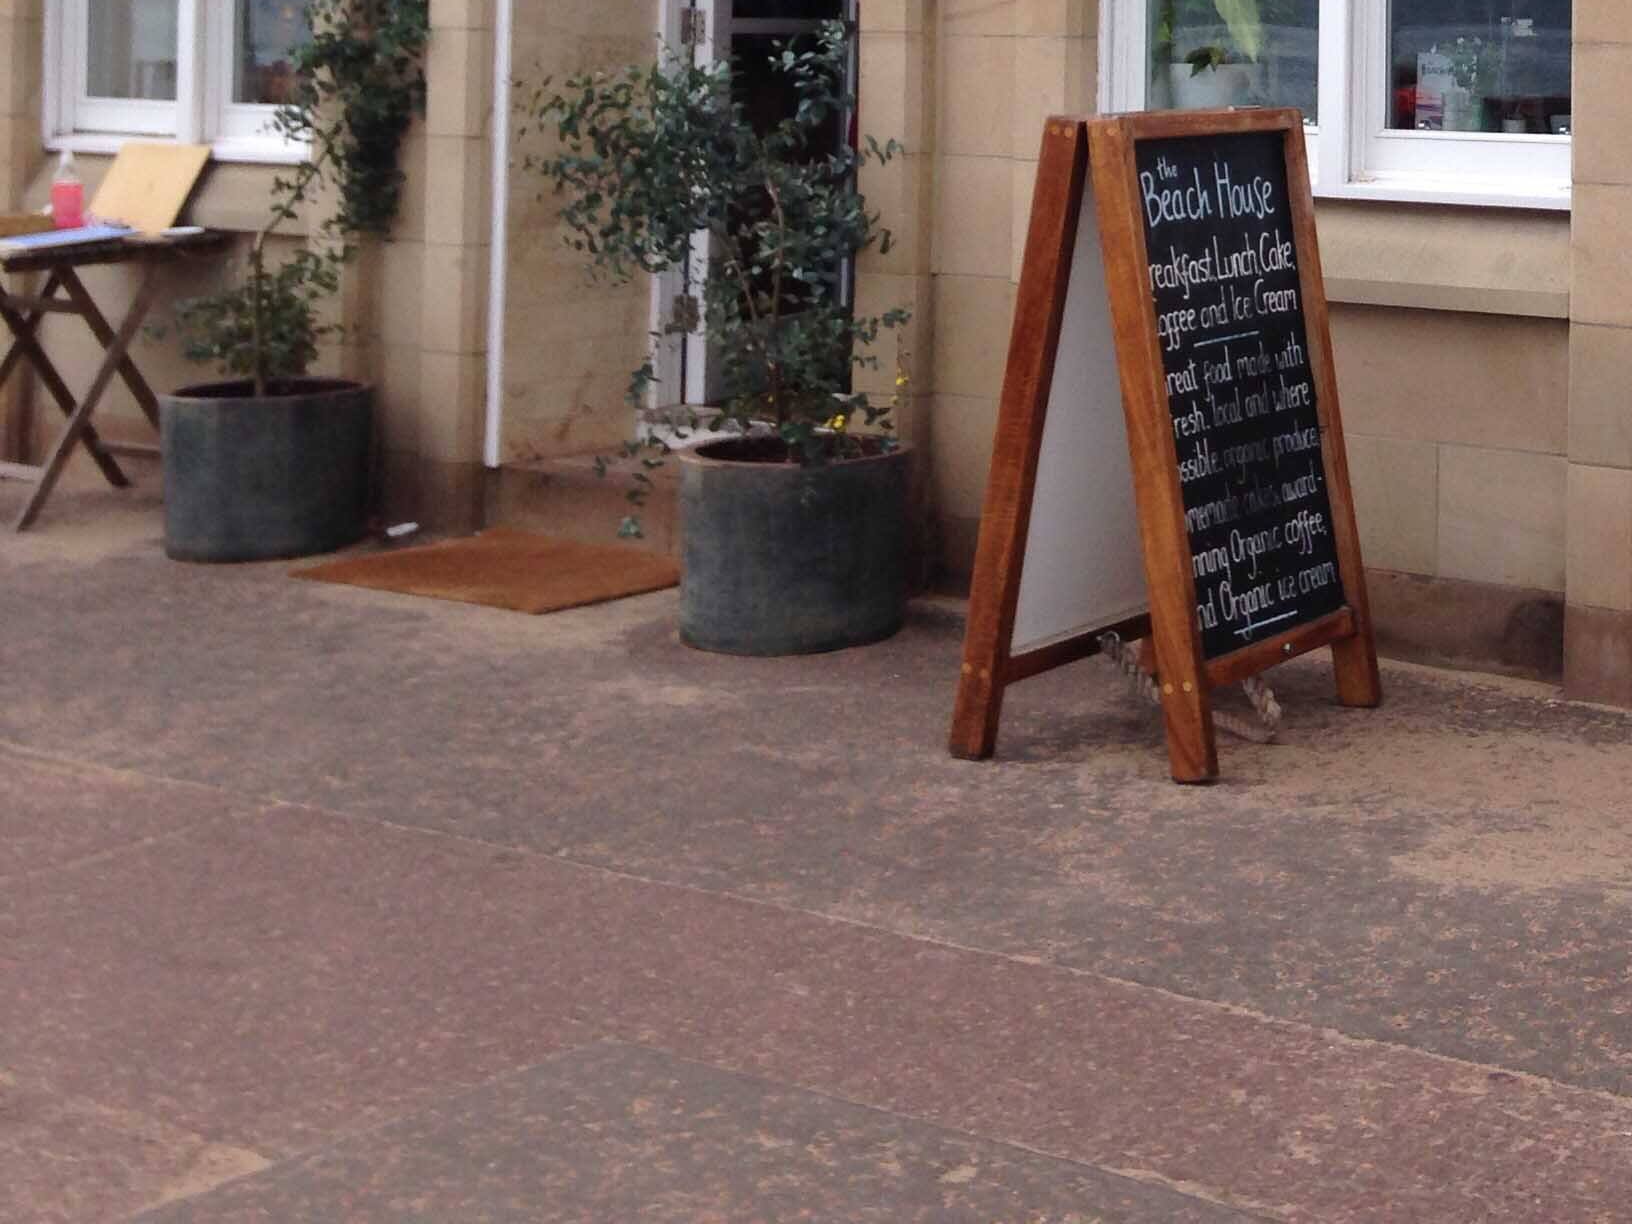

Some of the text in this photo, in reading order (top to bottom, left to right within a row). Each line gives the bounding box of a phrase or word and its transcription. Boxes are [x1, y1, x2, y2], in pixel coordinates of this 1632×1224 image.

[1139, 161, 1276, 228] Beach House
[1156, 155, 1179, 180] the
[1148, 245, 1217, 300] reakfast,
[1156, 278, 1298, 351] offee and Ice Cream
[1165, 331, 1305, 403] reat food made with
[1211, 387, 1243, 426] local
[1244, 380, 1269, 417] and
[1272, 374, 1311, 412] where
[1230, 529, 1283, 580] Organic
[1196, 561, 1337, 640] nd Organic ice cream
